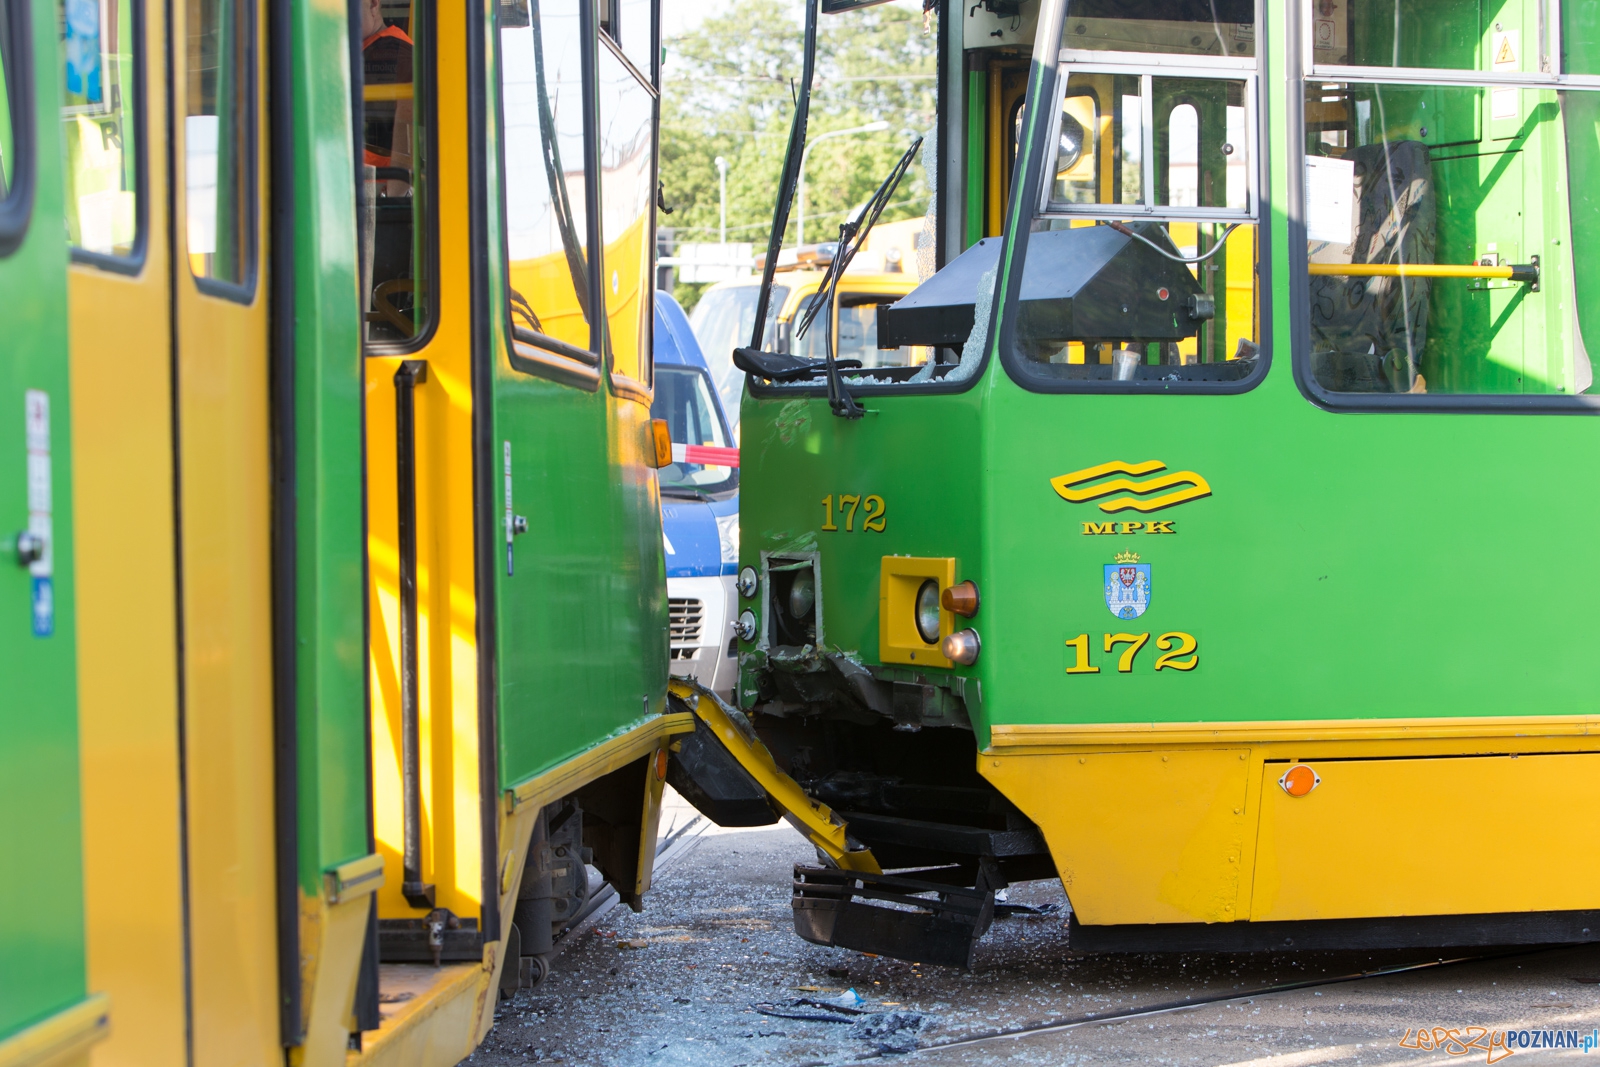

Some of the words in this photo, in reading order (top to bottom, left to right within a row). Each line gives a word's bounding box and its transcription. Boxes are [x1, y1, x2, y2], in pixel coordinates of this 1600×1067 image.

[821, 494, 887, 533] 172
[1081, 520, 1177, 535] MPK
[1065, 631, 1200, 674] 172
